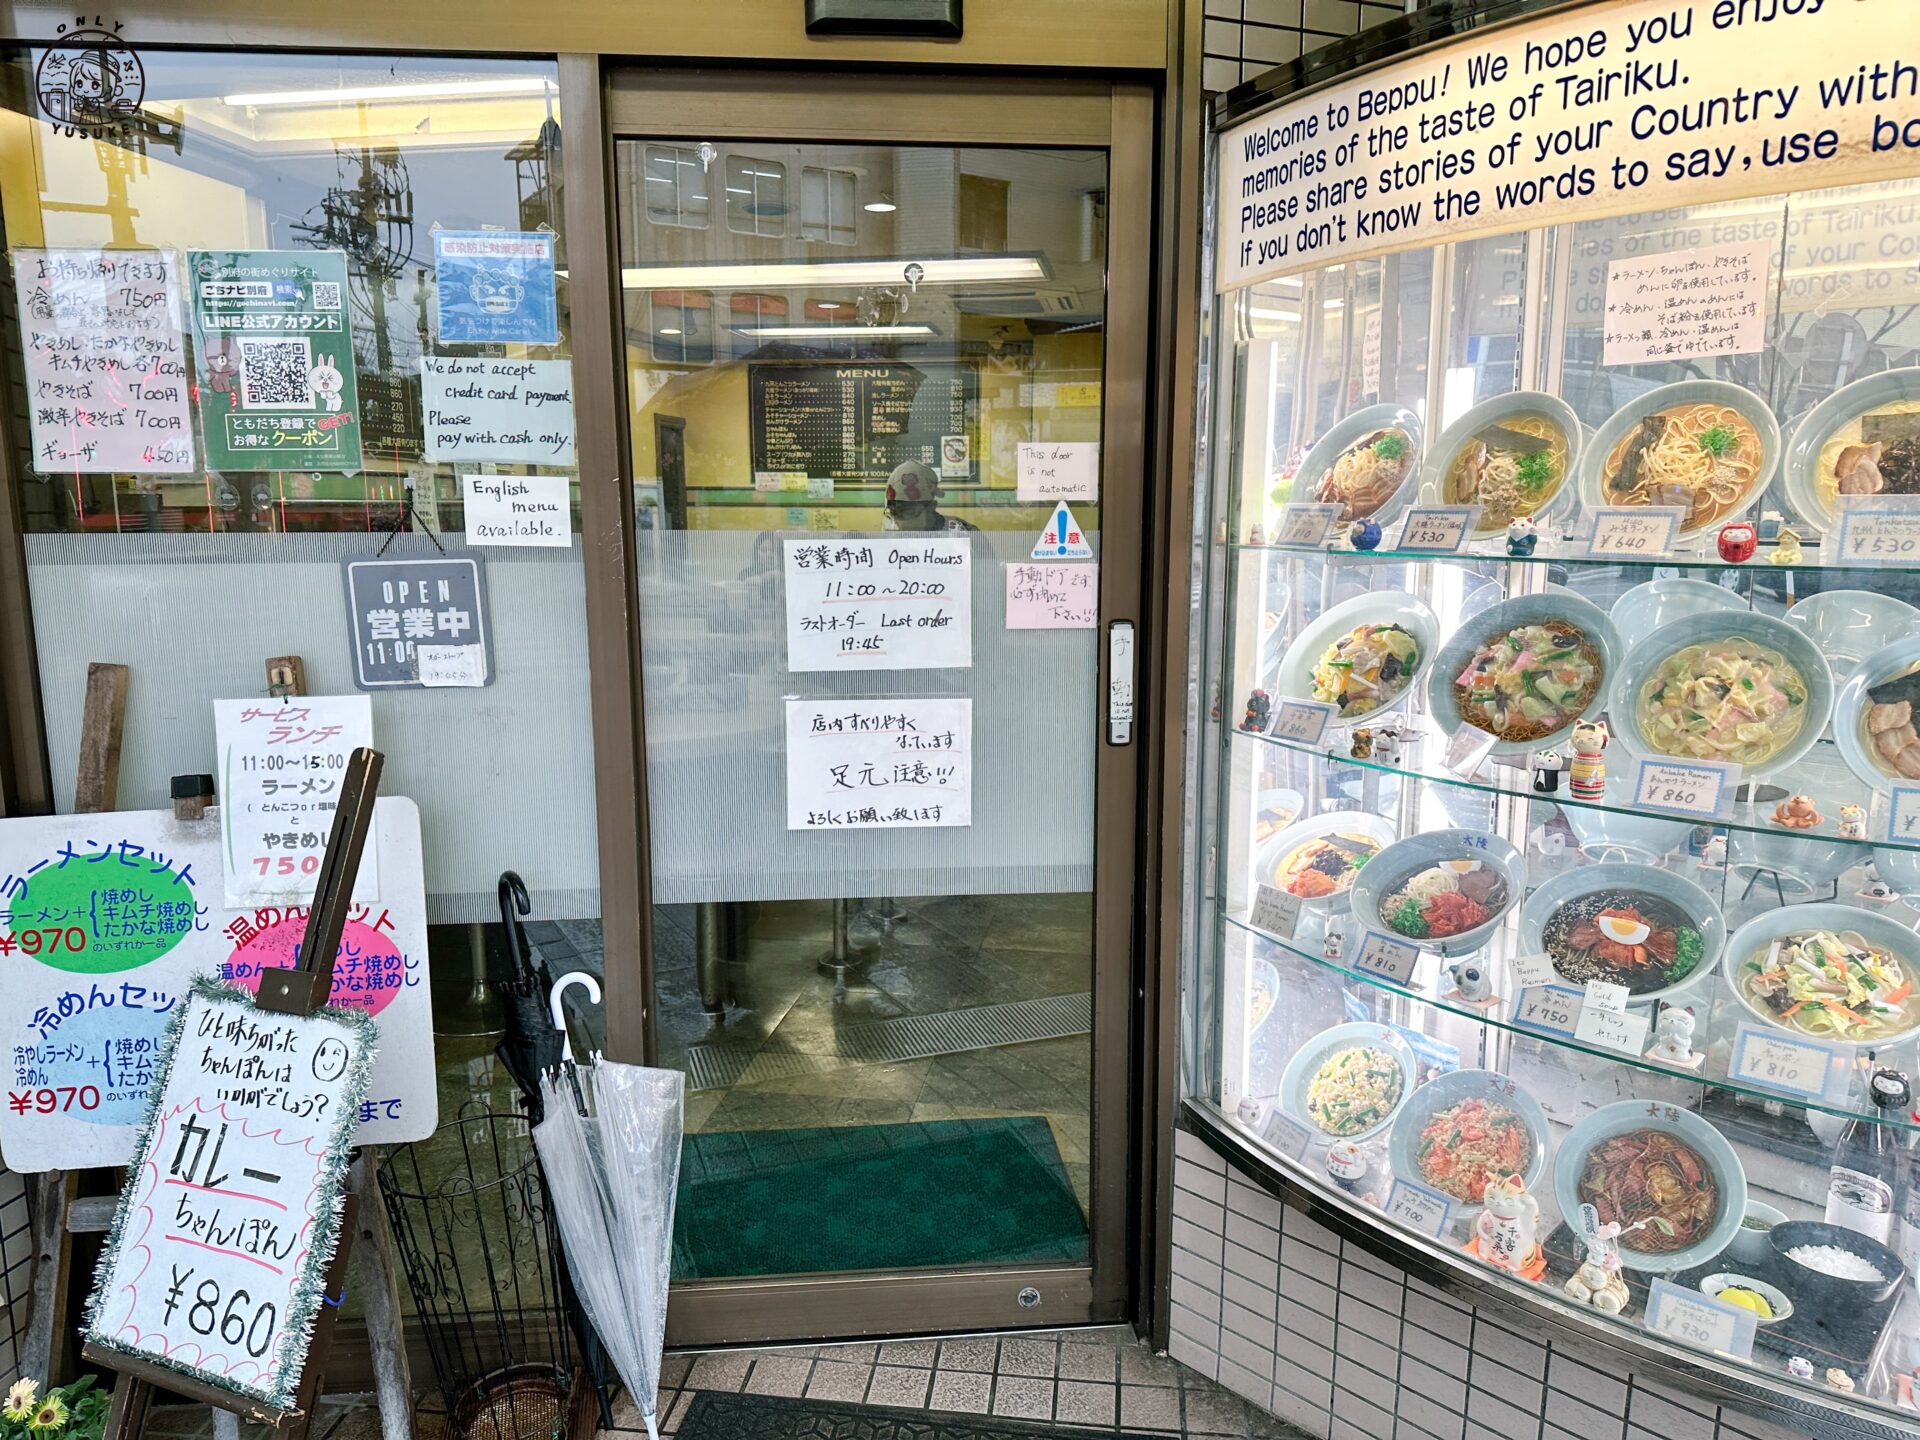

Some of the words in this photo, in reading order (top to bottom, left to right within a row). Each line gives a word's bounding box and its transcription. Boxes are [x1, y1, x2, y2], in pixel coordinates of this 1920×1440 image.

[1244, 115, 1318, 162] Welcome
[1327, 103, 1349, 131] to
[1358, 64, 1450, 122] Beppu!
[1468, 52, 1508, 89] We
[1525, 30, 1607, 74] hope
[1625, 8, 1692, 53] you
[1242, 149, 1326, 198] memories
[1335, 133, 1359, 167] of
[1368, 125, 1407, 157] the
[1419, 101, 1495, 143] taste
[1509, 83, 1544, 120] of
[1556, 58, 1690, 110] Tairiku.
[1241, 195, 1298, 233] Please
[1306, 176, 1367, 212] share
[1379, 149, 1474, 194] stories
[1488, 132, 1522, 169] of
[1534, 119, 1613, 163] your
[1631, 86, 1799, 140] Country
[1819, 60, 1918, 109] with
[1240, 240, 1253, 267] If
[1258, 234, 1288, 265] you
[1297, 215, 1346, 251] don't
[1357, 202, 1421, 238] know
[1434, 189, 1481, 221] the
[1496, 164, 1595, 210] words
[1611, 156, 1649, 190] to
[1762, 129, 1839, 167] use
[120, 288, 166, 309] 750円
[205, 315, 338, 329] LINE公式アカウント
[425, 360, 445, 374] We
[448, 359, 462, 374] do
[466, 361, 486, 374] not
[492, 363, 537, 381] accept
[836, 369, 889, 378] MENU
[35, 379, 93, 399] やきそば
[129, 383, 178, 402] 700円
[445, 382, 483, 399] credit
[487, 385, 518, 400] card
[135, 410, 181, 429] 700円
[232, 417, 316, 430] ともだち登録で
[318, 412, 355, 430] GET!
[429, 410, 471, 426] Please
[234, 434, 269, 446] お得な
[272, 430, 333, 446] クーポン
[437, 433, 461, 449] pay
[465, 430, 496, 443] with
[500, 430, 533, 444] cash
[539, 432, 572, 454] only.
[1023, 448, 1044, 460] This
[1051, 446, 1073, 460] door
[1027, 467, 1035, 475] is
[1041, 468, 1056, 477] not
[473, 480, 529, 502] English
[1040, 485, 1087, 493] automatic
[512, 502, 559, 513] menu
[477, 520, 561, 537] available.
[1409, 531, 1445, 542] ¥530
[1600, 535, 1646, 548] ¥640
[1853, 537, 1915, 552] ¥530
[794, 545, 873, 570] 営業時間
[888, 550, 919, 569] Open
[924, 548, 962, 565] Hours
[382, 580, 450, 604] OPEN
[367, 607, 470, 640] 営業中
[800, 610, 865, 632] ラストオーダー
[881, 613, 913, 628] Last
[918, 609, 952, 627] order
[842, 635, 884, 651] 19:45
[241, 707, 311, 723] サービス
[267, 725, 343, 745] ランチ
[262, 778, 336, 796] ラーメン
[1648, 785, 1695, 803] ¥860
[290, 816, 299, 825] と
[807, 805, 943, 825] よろしくお願い致します
[0, 839, 196, 901] ラーメンセット
[253, 856, 319, 876] 750
[101, 888, 154, 905] 焼めし
[103, 900, 209, 920] キムチ焼めし
[104, 917, 210, 937] たかな焼めし
[0, 927, 86, 956] ¥970
[93, 938, 167, 952] のいずれか一品
[1365, 952, 1396, 971] ¥810
[27, 983, 176, 1040] 冷めんセッ
[1527, 1004, 1568, 1024] ¥750
[198, 1008, 299, 1053] ひと味ちがった
[14, 1043, 84, 1065] 冷やしラーメン
[201, 1045, 292, 1082] ちゃんぽんは
[16, 1068, 49, 1087] 冷めん
[1750, 1057, 1797, 1079] ¥810
[8, 1085, 100, 1115] ¥970
[170, 1113, 281, 1188] カレー
[1394, 1200, 1423, 1222] ¥700
[176, 1192, 296, 1261] ちゃんぽん
[164, 1263, 276, 1358] ¥860
[1664, 1314, 1710, 1341] ¥930
